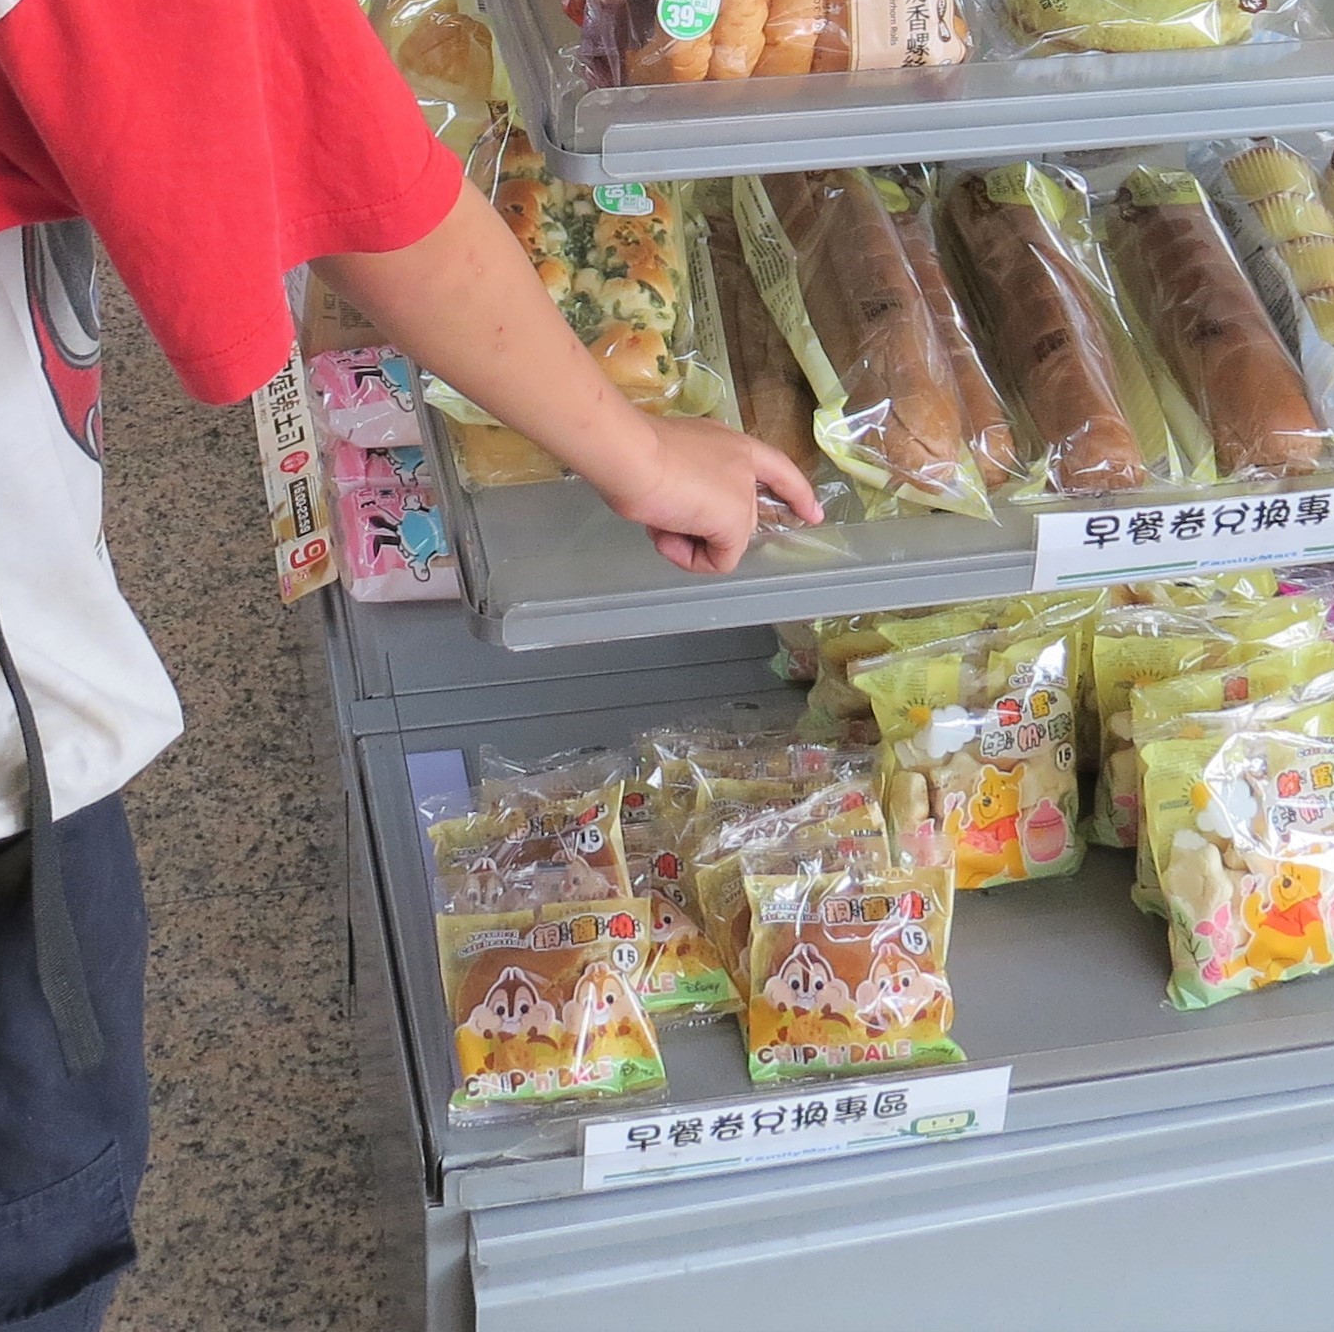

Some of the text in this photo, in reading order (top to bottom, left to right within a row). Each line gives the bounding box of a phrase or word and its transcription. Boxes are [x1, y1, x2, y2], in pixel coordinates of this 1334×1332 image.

[666, 4, 695, 27] 39
[616, 946, 637, 963] 15
[757, 1046, 818, 1066] CHIP
[849, 1040, 911, 1062] DALE
[466, 1070, 526, 1098] CHIP
